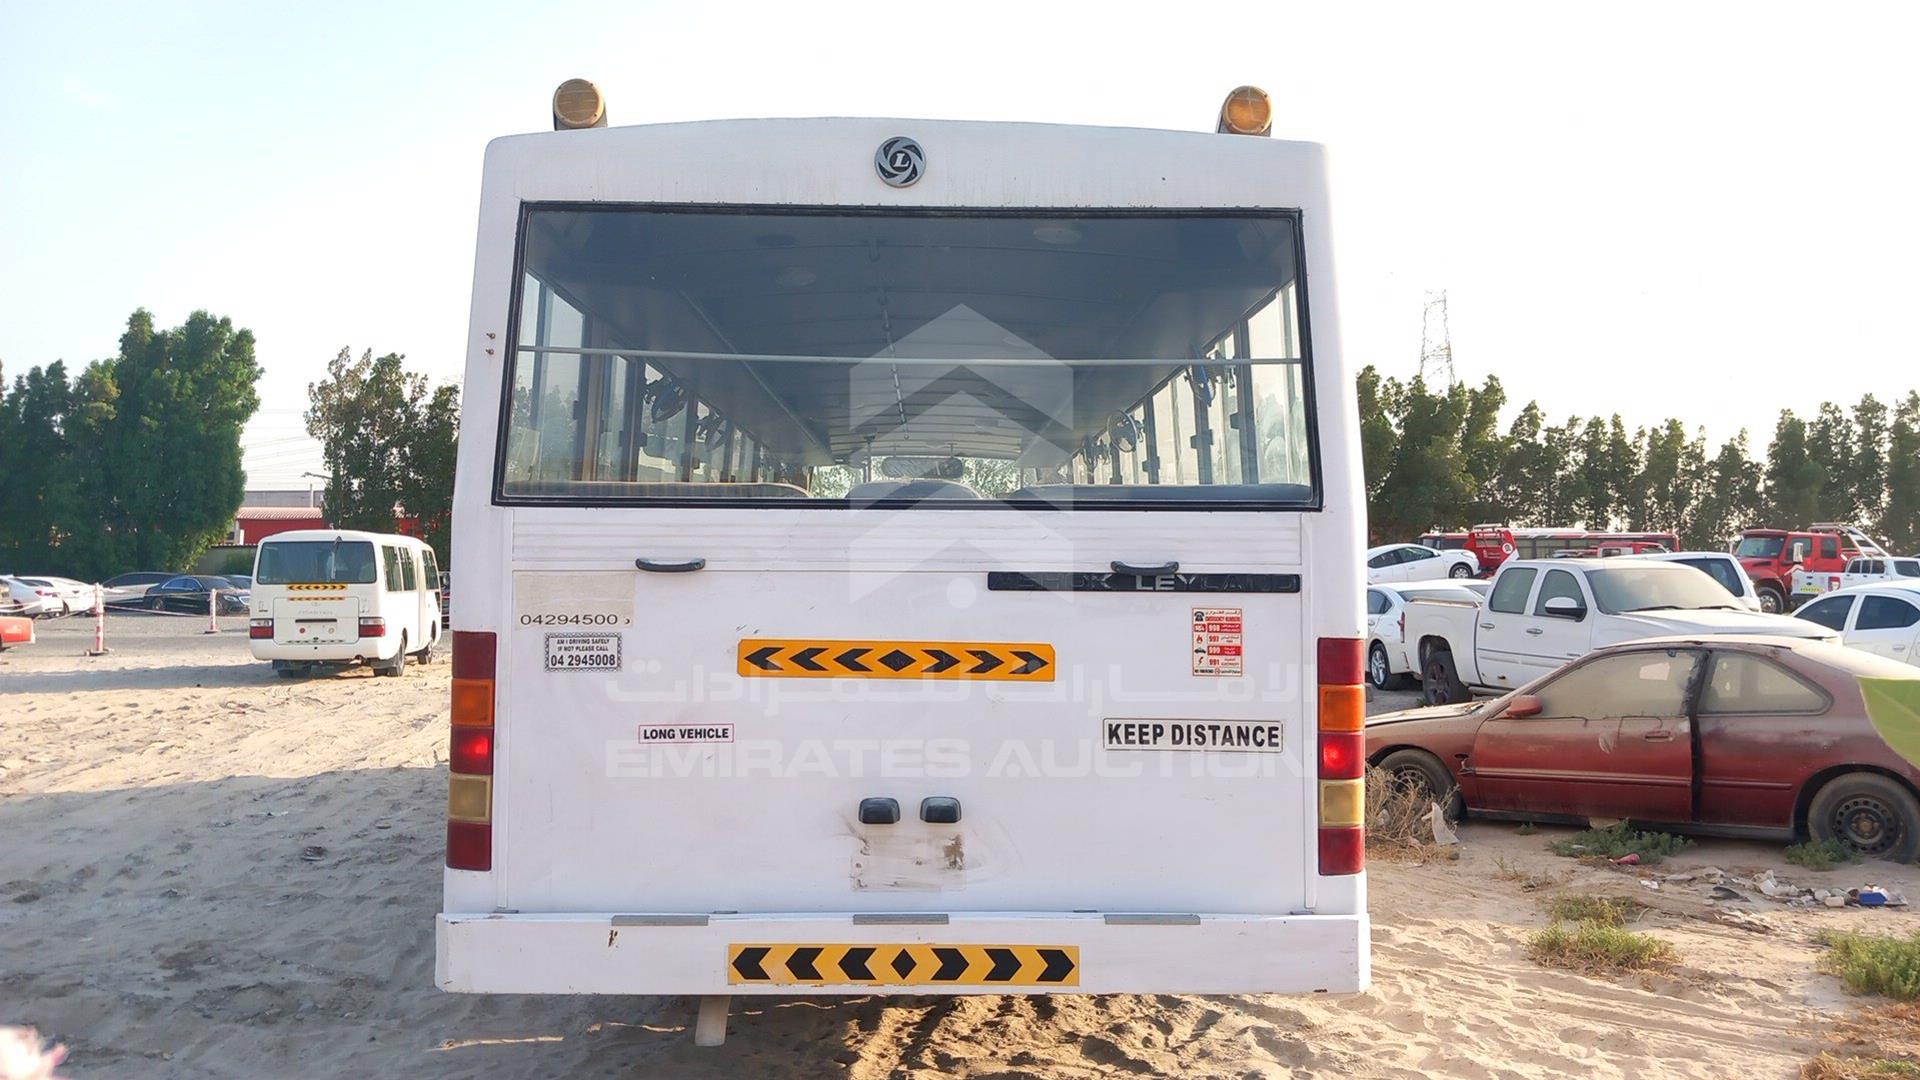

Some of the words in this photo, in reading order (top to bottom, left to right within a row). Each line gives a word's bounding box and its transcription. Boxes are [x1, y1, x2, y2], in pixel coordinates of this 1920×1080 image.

[893, 153, 910, 167] L
[520, 614, 631, 625] 04294500
[550, 655, 564, 666] 04
[567, 654, 616, 666] 2945008
[643, 728, 676, 740] LONG
[679, 727, 729, 740] VEHICLE
[1107, 723, 1164, 746] KEEP
[1171, 724, 1280, 748] DISTANCE
